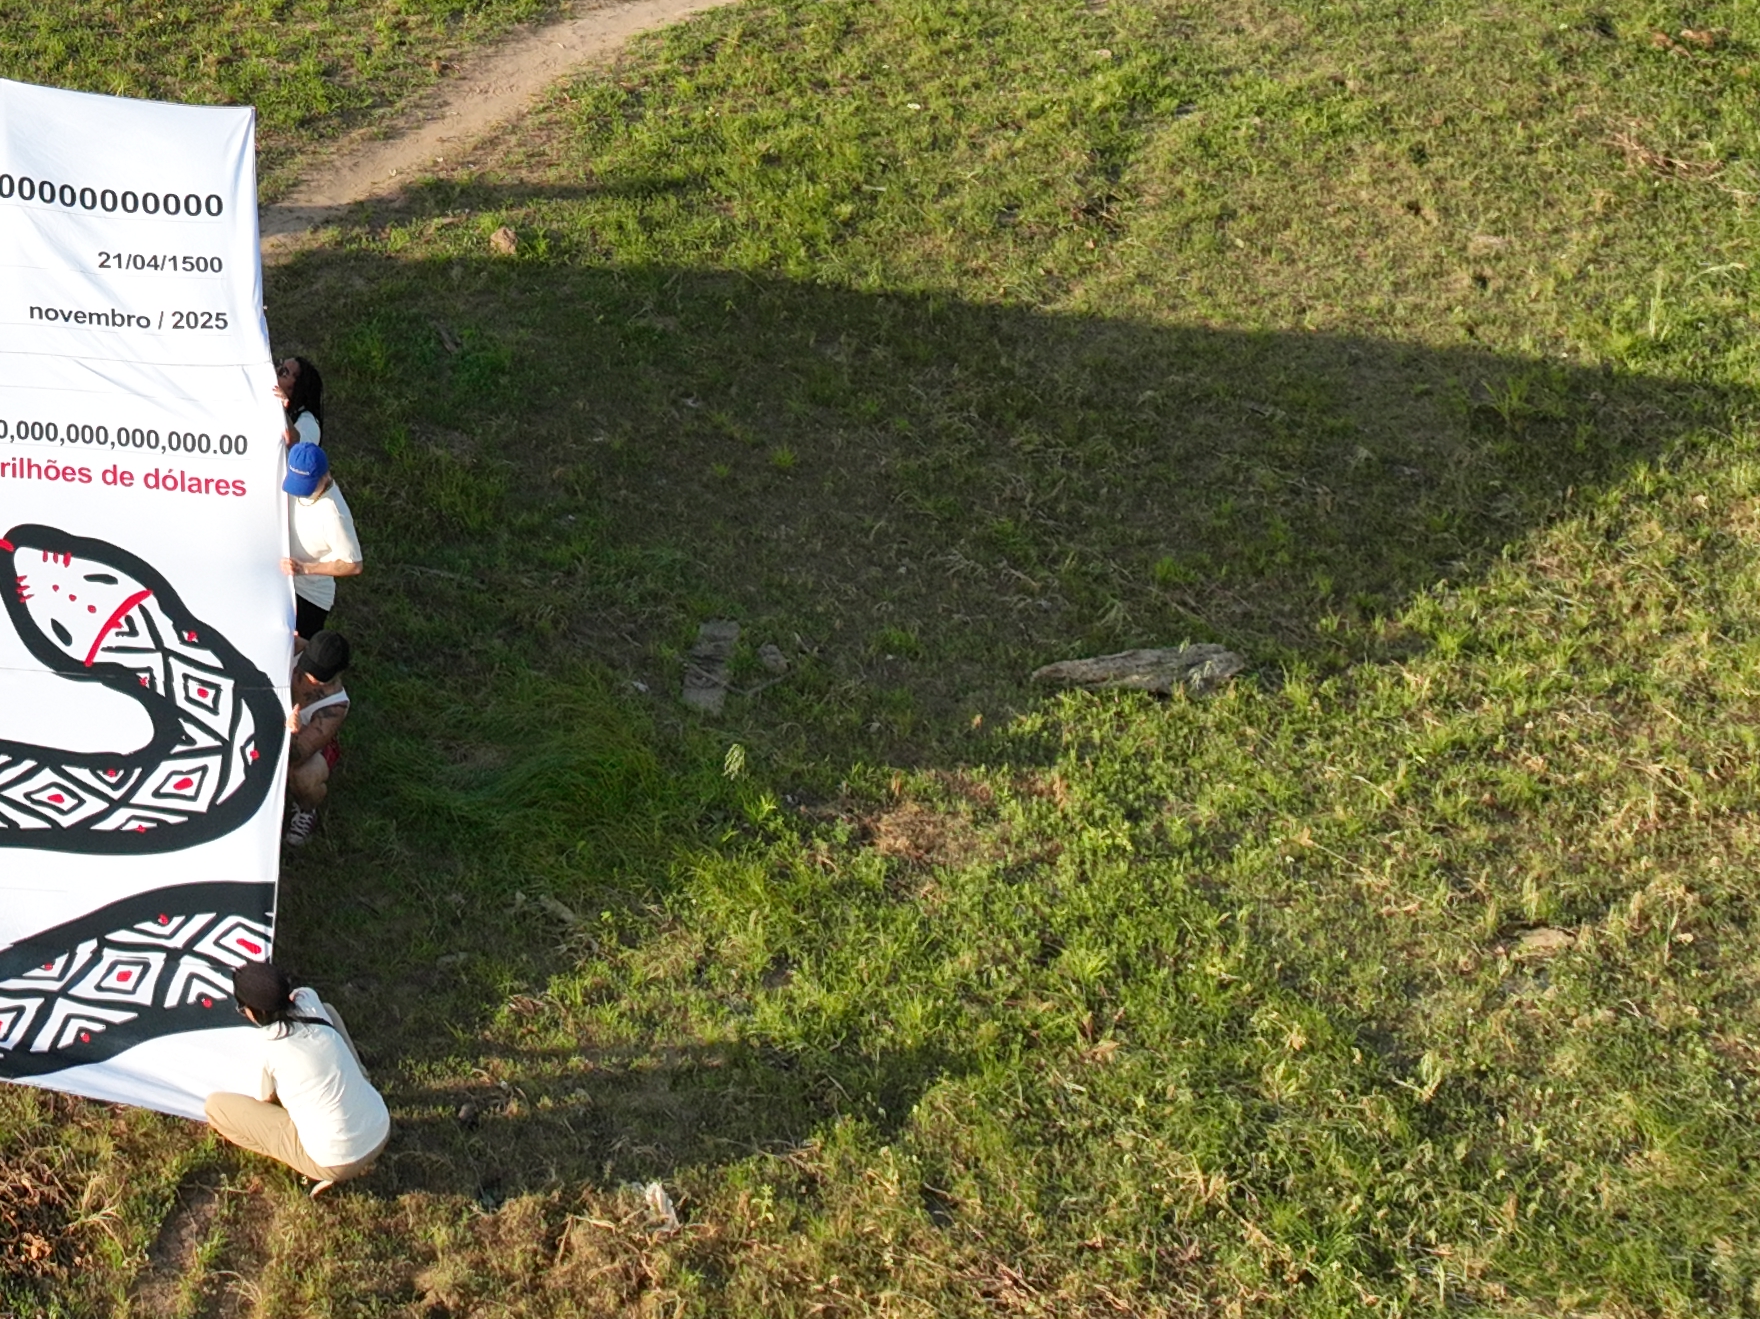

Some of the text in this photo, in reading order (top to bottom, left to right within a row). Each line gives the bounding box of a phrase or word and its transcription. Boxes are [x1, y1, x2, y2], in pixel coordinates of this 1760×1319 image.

[98, 251, 223, 273] 21/04/1500
[29, 306, 228, 330] novembro / 2025
[101, 464, 135, 487] de
[143, 468, 247, 497] dólares
